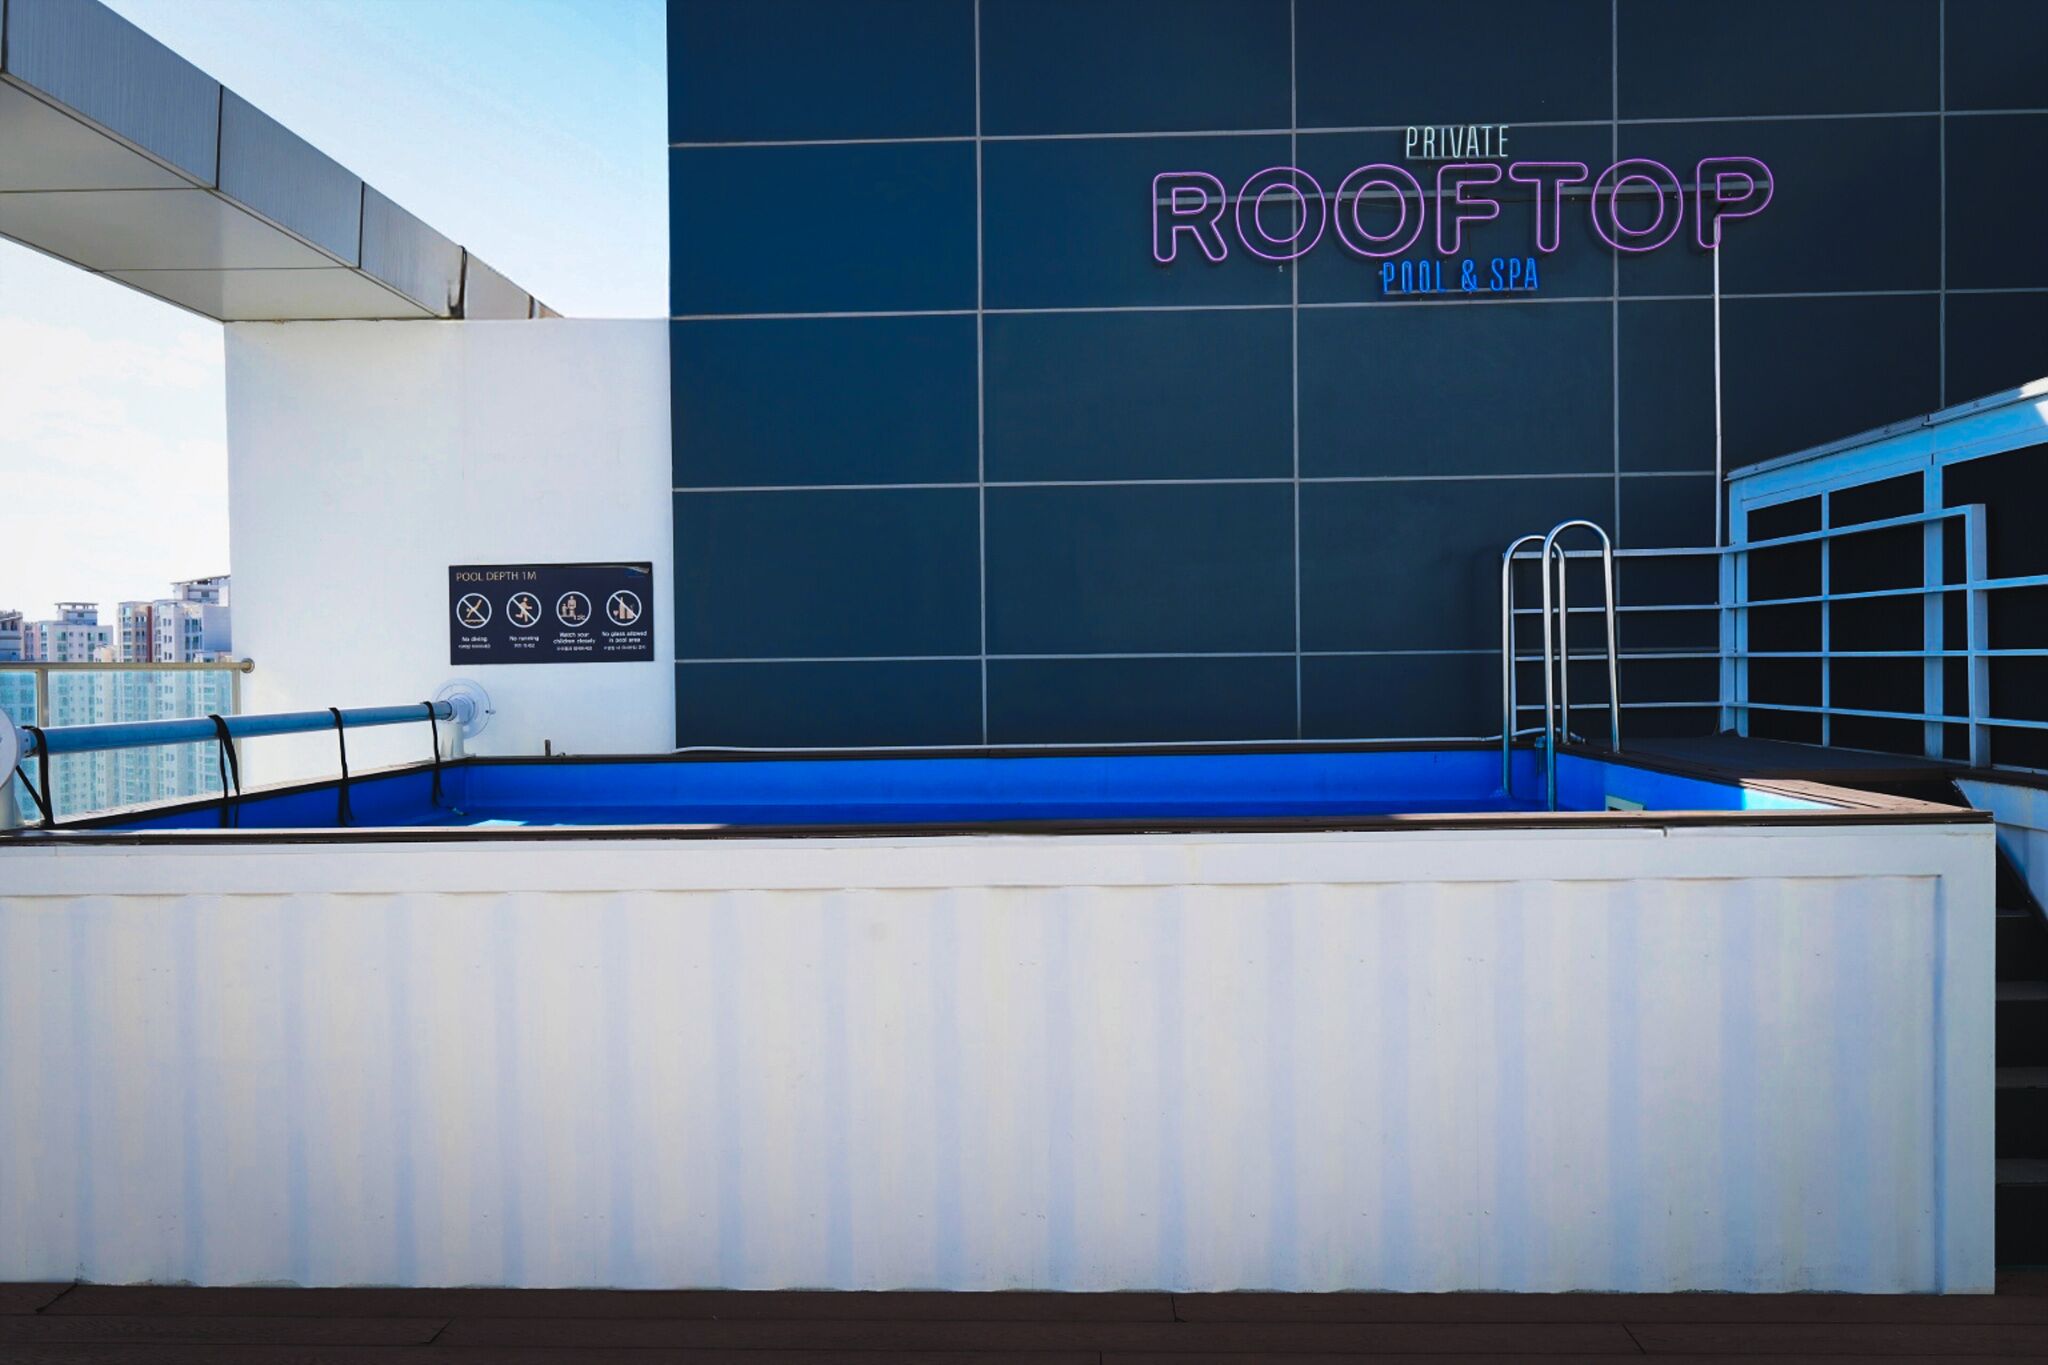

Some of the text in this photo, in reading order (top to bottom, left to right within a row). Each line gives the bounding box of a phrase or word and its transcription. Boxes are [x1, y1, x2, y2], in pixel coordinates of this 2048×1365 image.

[1405, 125, 1510, 159] PRIVATE
[1152, 156, 1775, 263] ROOFTOP
[1382, 256, 1539, 295] POOL & SPA
[456, 570, 537, 582] POOL DEPTH 1M
